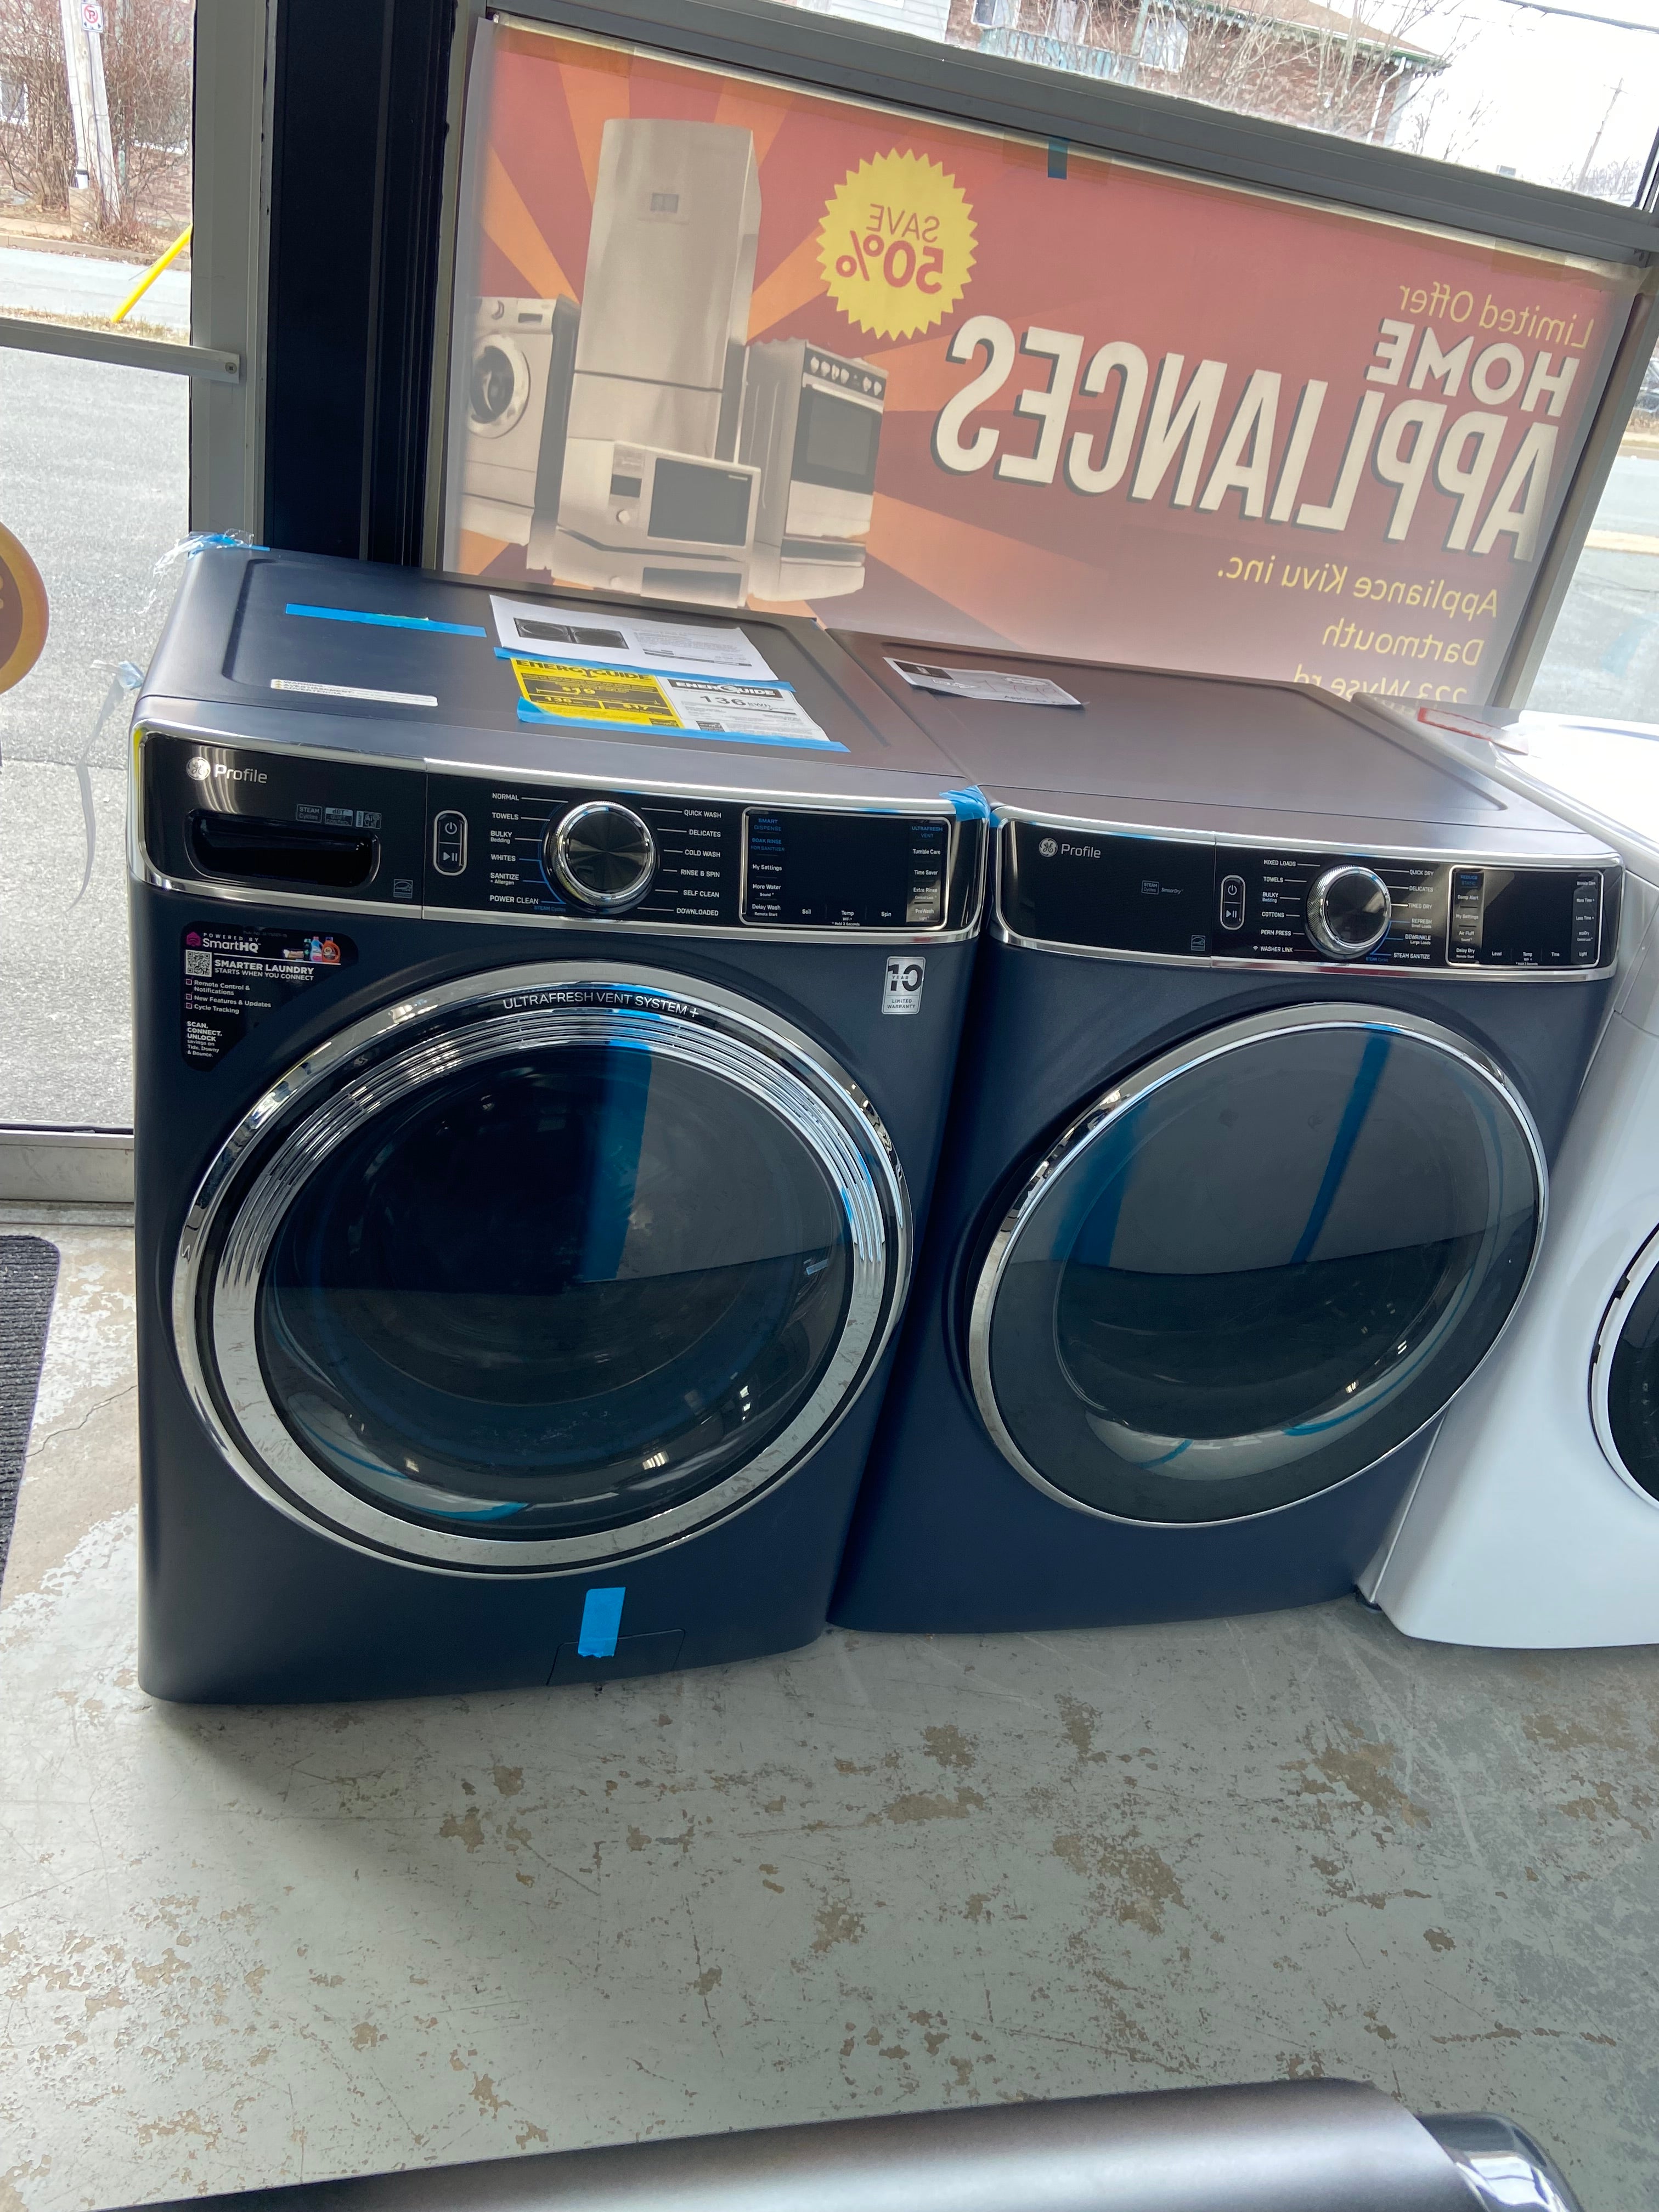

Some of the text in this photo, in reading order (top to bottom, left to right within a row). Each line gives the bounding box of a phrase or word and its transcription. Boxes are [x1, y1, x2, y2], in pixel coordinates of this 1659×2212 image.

[699, 696, 746, 706] 136
[215, 764, 268, 783] Profile
[492, 793, 520, 801] NORMAL
[492, 812, 519, 820] TOWELS
[689, 829, 721, 838] DELICATES
[1061, 843, 1101, 858] Profile
[490, 854, 516, 862] WHITES
[676, 907, 719, 916] DOWNLOADED
[204, 933, 243, 941] POWERED
[215, 959, 314, 975] SMARTER LAUNDRY
[215, 967, 240, 975] STARTS
[888, 964, 923, 991] 10
[194, 986, 234, 996] Notifications
[210, 997, 237, 1005] Features
[503, 992, 593, 1009] ULTRAFRESH
[596, 992, 633, 1005] VENT
[634, 995, 687, 1015] SYSTEM
[212, 1006, 240, 1014] Tracking
[187, 1033, 216, 1042] UNLOCK
